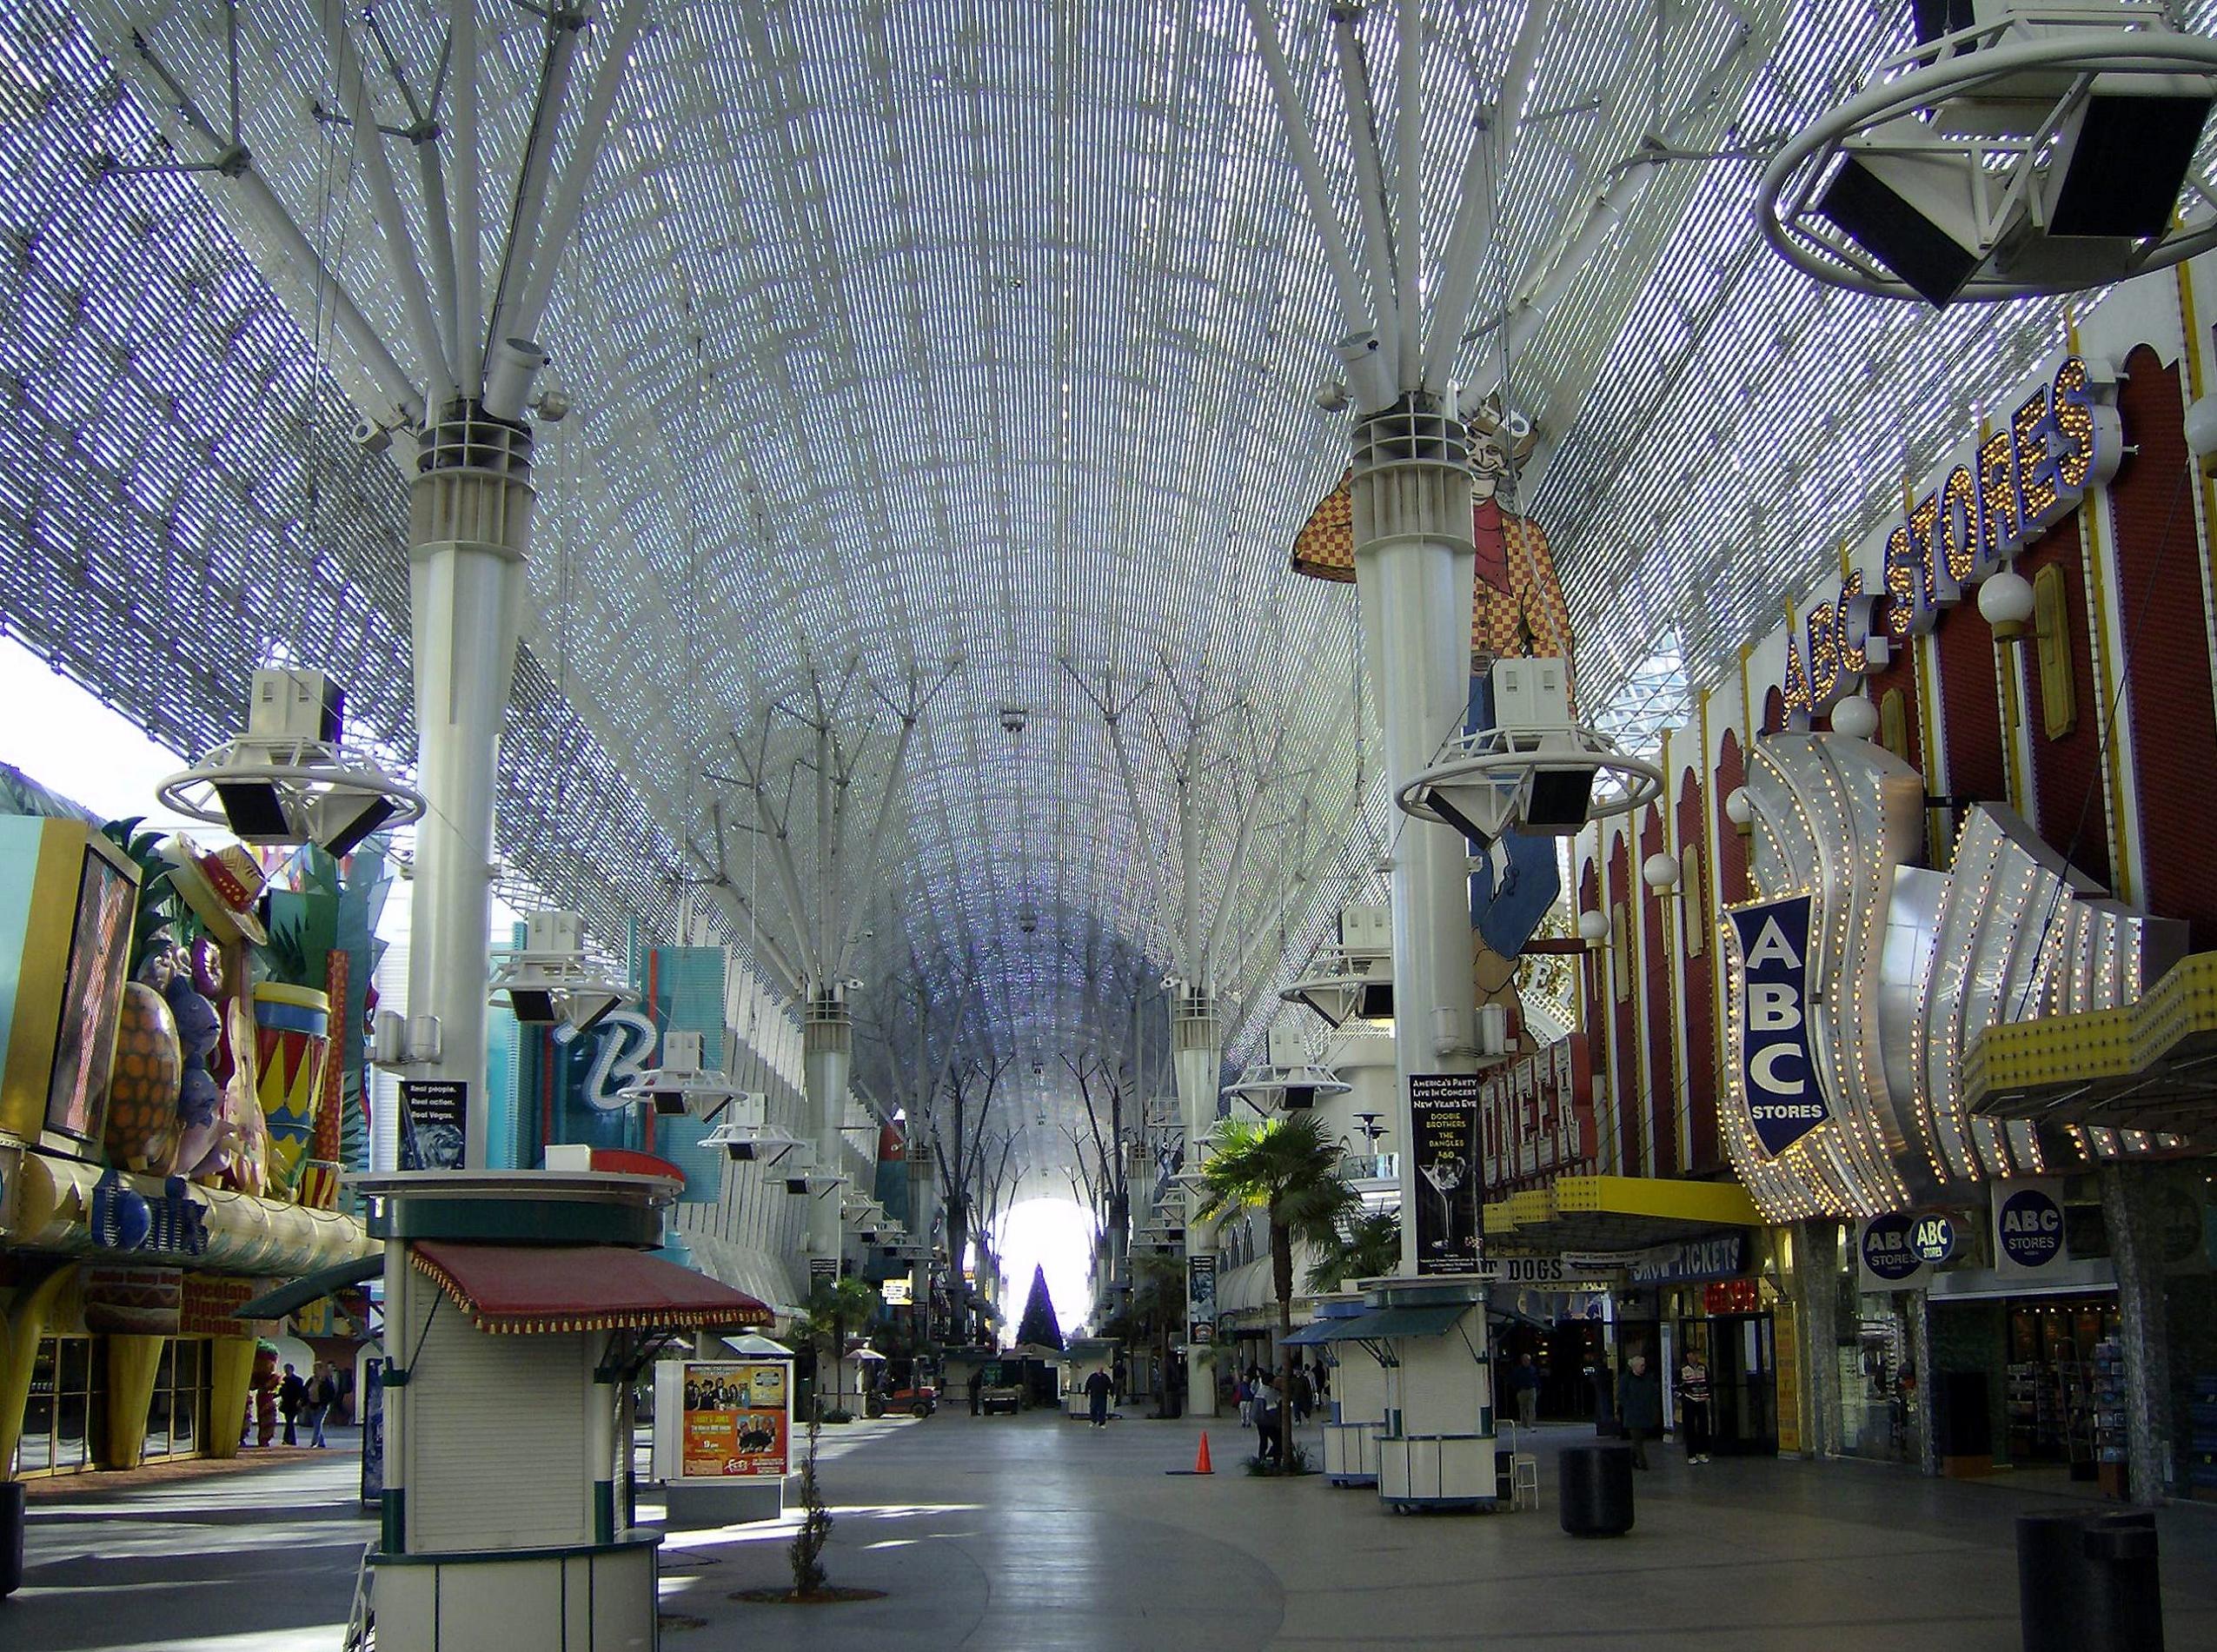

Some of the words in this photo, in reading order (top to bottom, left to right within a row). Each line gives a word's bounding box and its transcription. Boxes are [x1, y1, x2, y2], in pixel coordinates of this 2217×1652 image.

[1782, 597, 1867, 732] ABC
[1883, 356, 2095, 636] STORES
[1745, 914, 1804, 1096] ABC
[1751, 1105, 1822, 1121] STORES
[1916, 1218, 1948, 1247] ABC
[2004, 1210, 2059, 1232] ABC
[2008, 1236, 2055, 1251] STORES
[1508, 1258, 1563, 1281] DOGS
